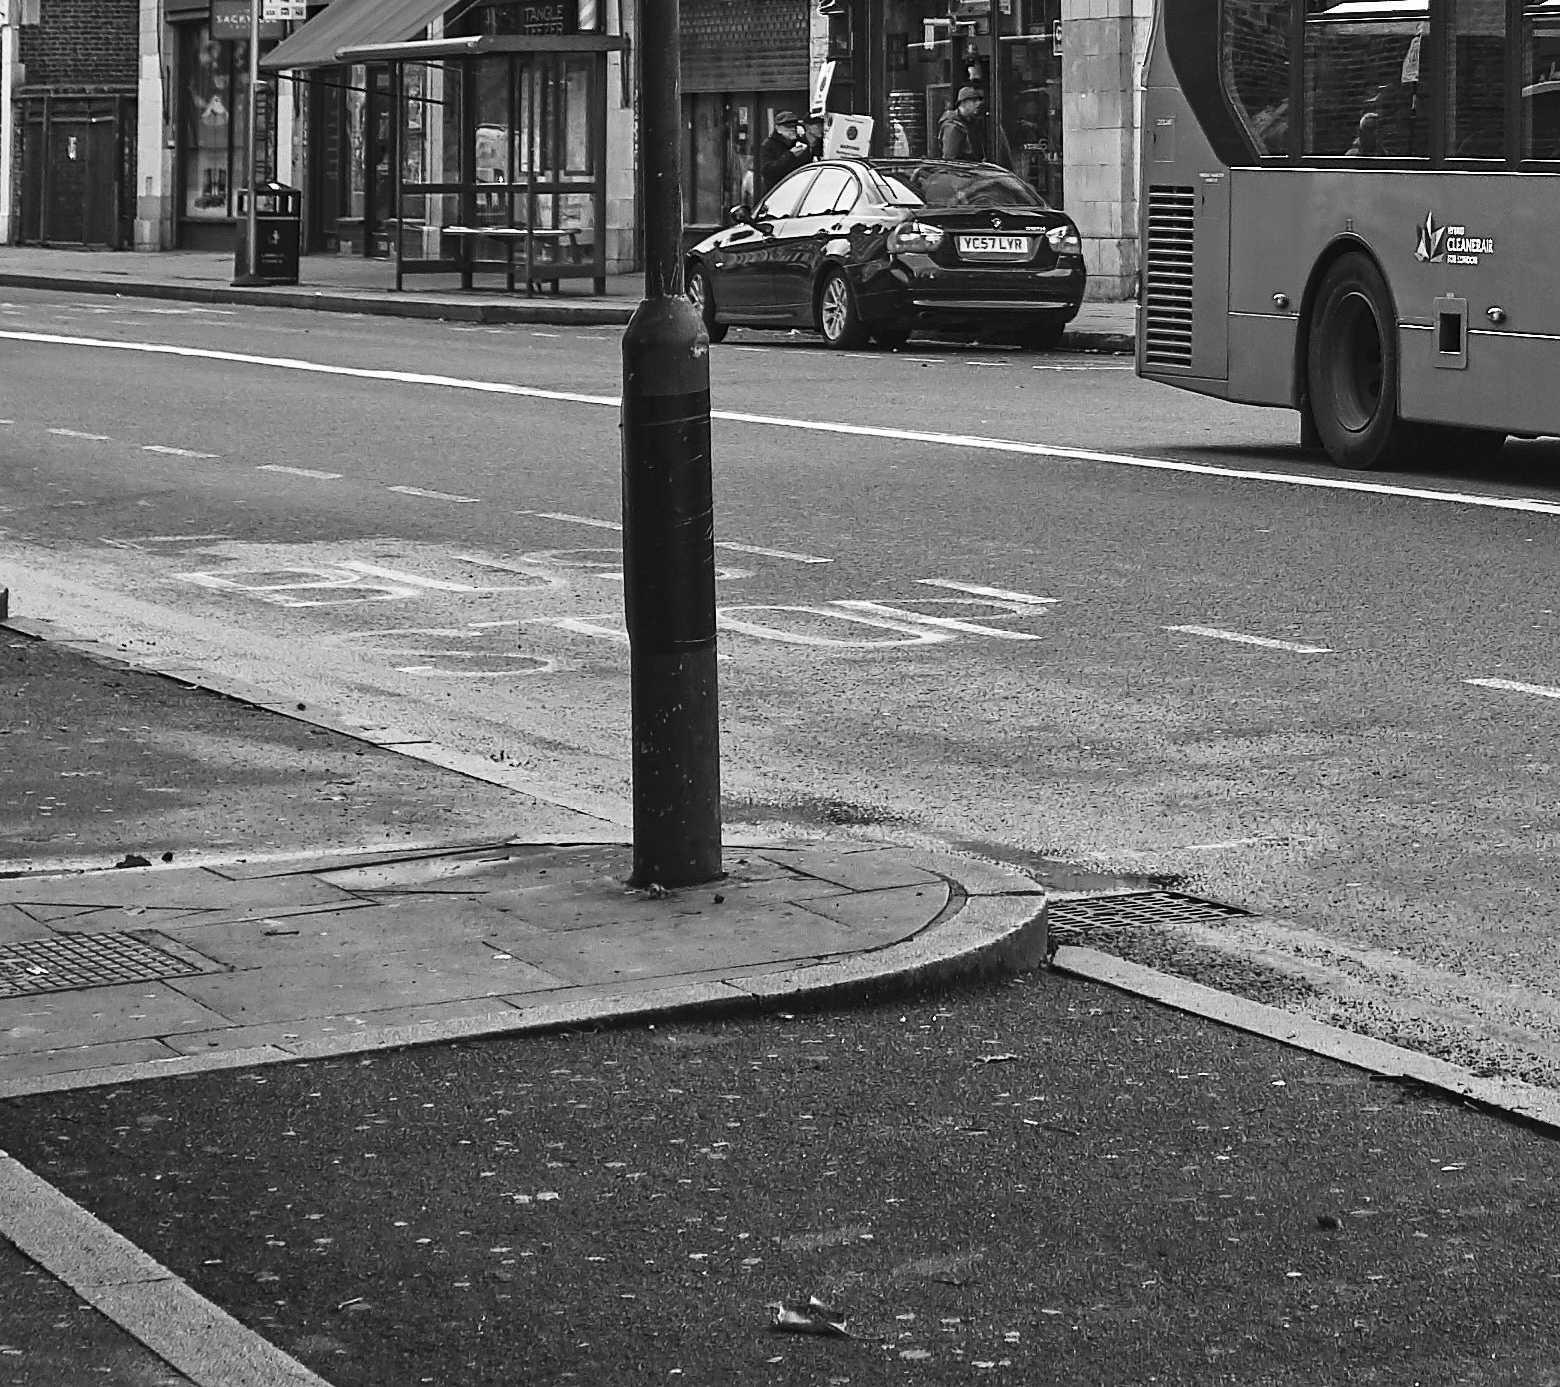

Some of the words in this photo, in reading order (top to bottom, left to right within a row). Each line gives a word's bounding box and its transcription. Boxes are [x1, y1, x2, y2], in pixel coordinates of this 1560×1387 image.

[523, 5, 564, 21] TANGLE
[963, 238, 996, 249] YC57
[999, 239, 1022, 251] LYR
